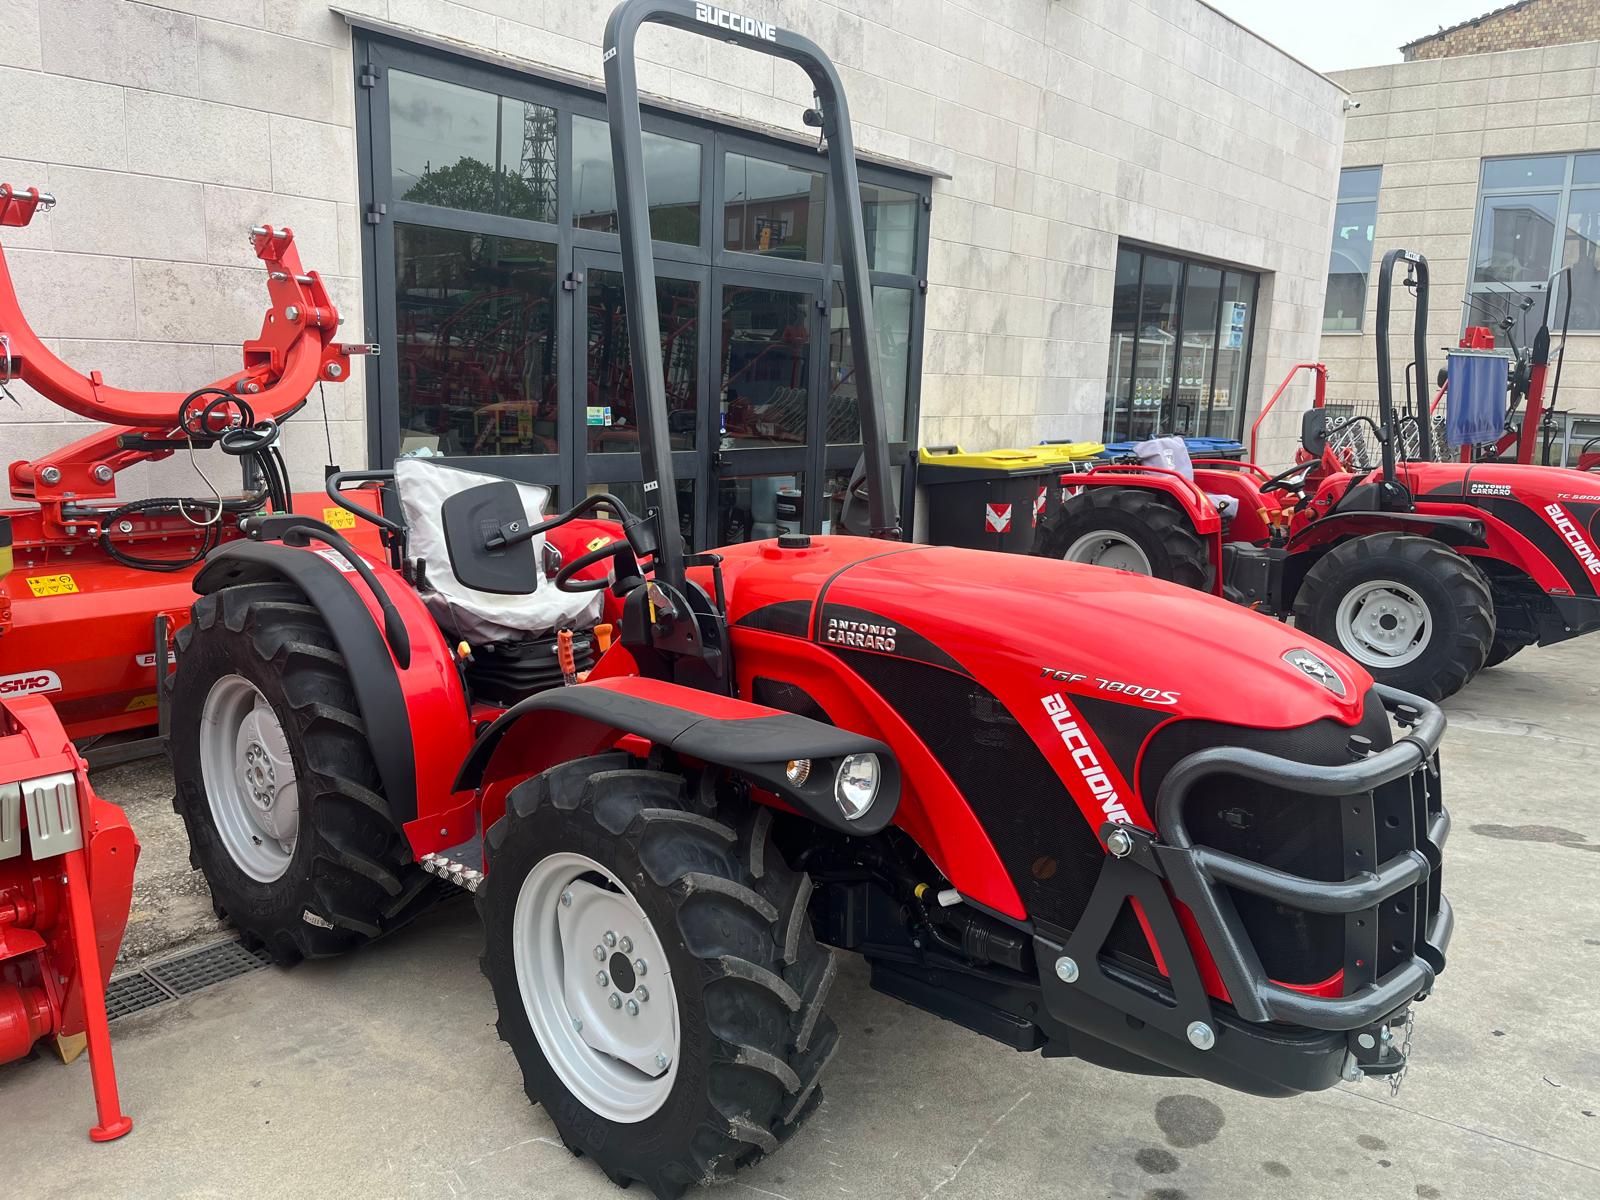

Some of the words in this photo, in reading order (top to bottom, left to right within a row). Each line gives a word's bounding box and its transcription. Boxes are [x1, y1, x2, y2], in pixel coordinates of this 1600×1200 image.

[696, 3, 776, 41] BUCCIONE
[1471, 488, 1511, 496] CARRARO
[1544, 503, 1600, 575] BUCCIONE
[828, 629, 895, 651] CARRARO
[829, 619, 896, 636] ANTONIO
[1040, 667, 1087, 683] TGF
[1095, 677, 1182, 705] 7800S
